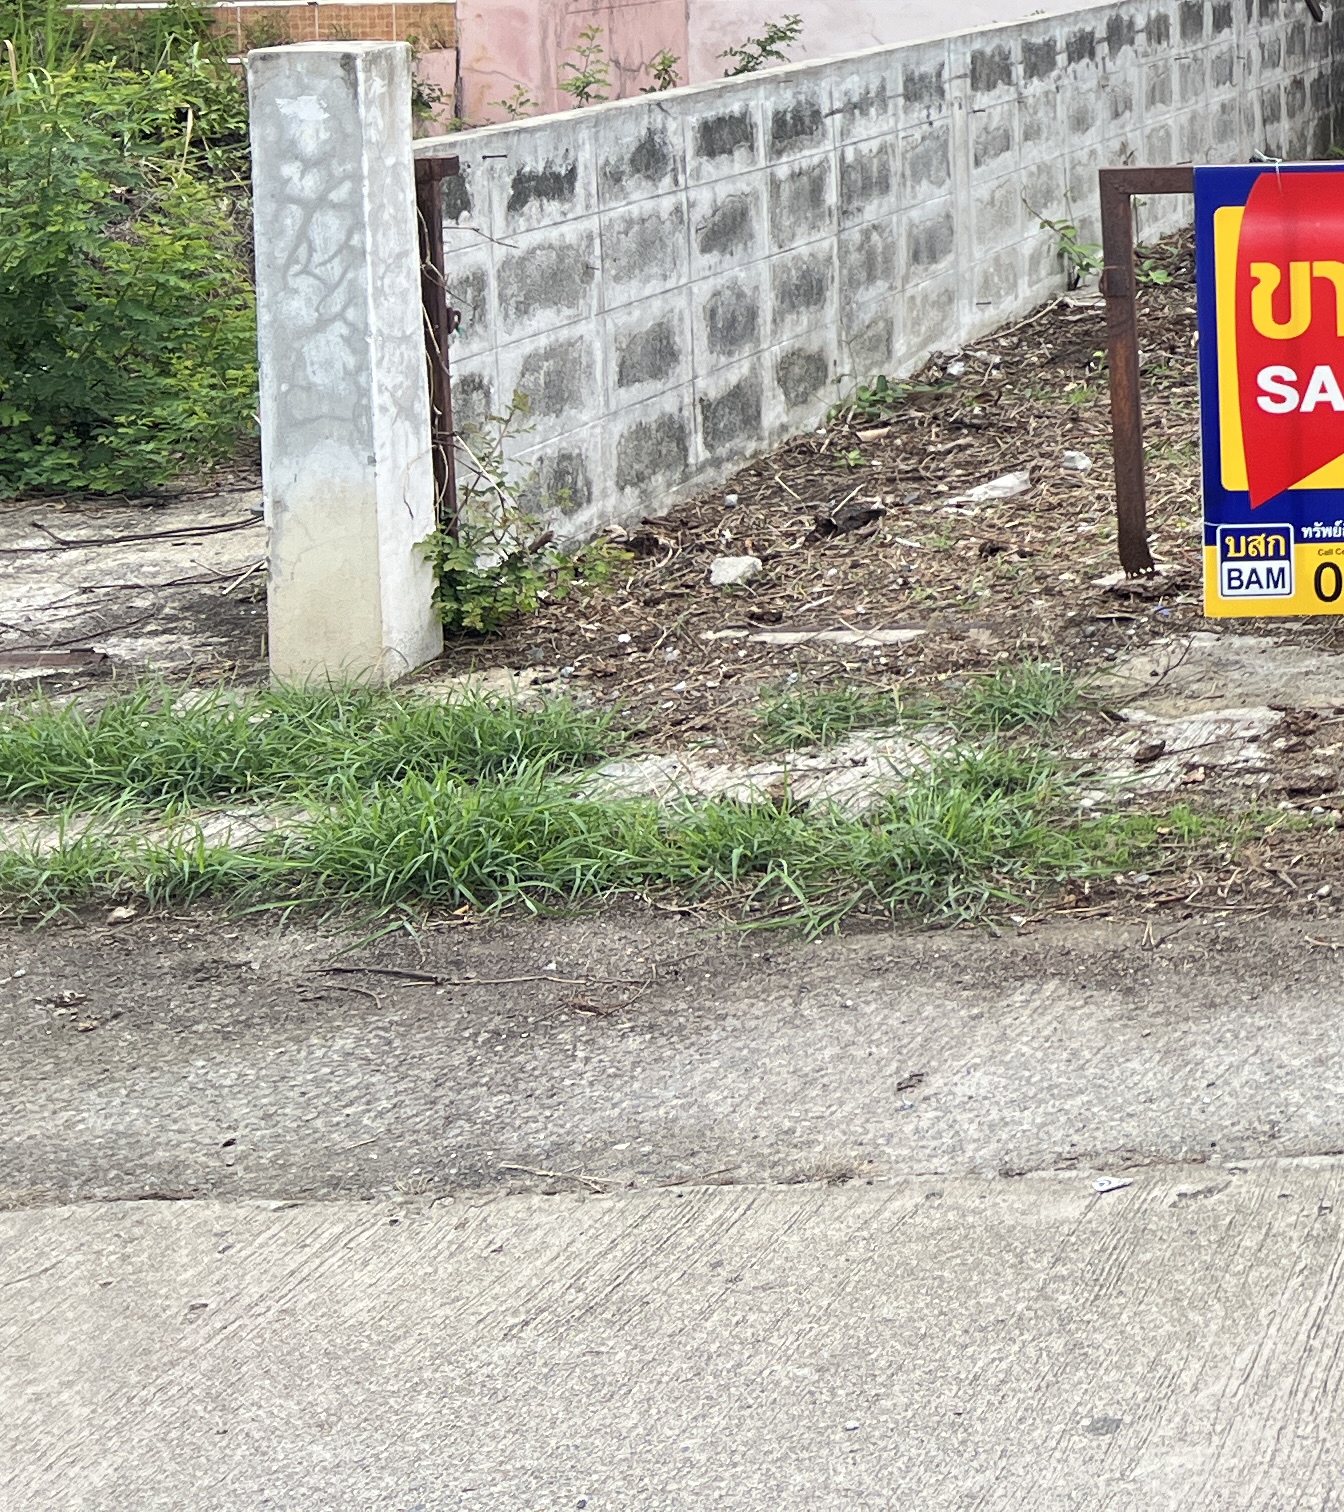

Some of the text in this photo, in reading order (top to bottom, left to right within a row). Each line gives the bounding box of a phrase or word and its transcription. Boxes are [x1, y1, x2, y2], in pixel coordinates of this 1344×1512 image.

[1224, 531, 1286, 558] บสก
[1317, 548, 1334, 557] Call
[1227, 567, 1286, 591] BAM
